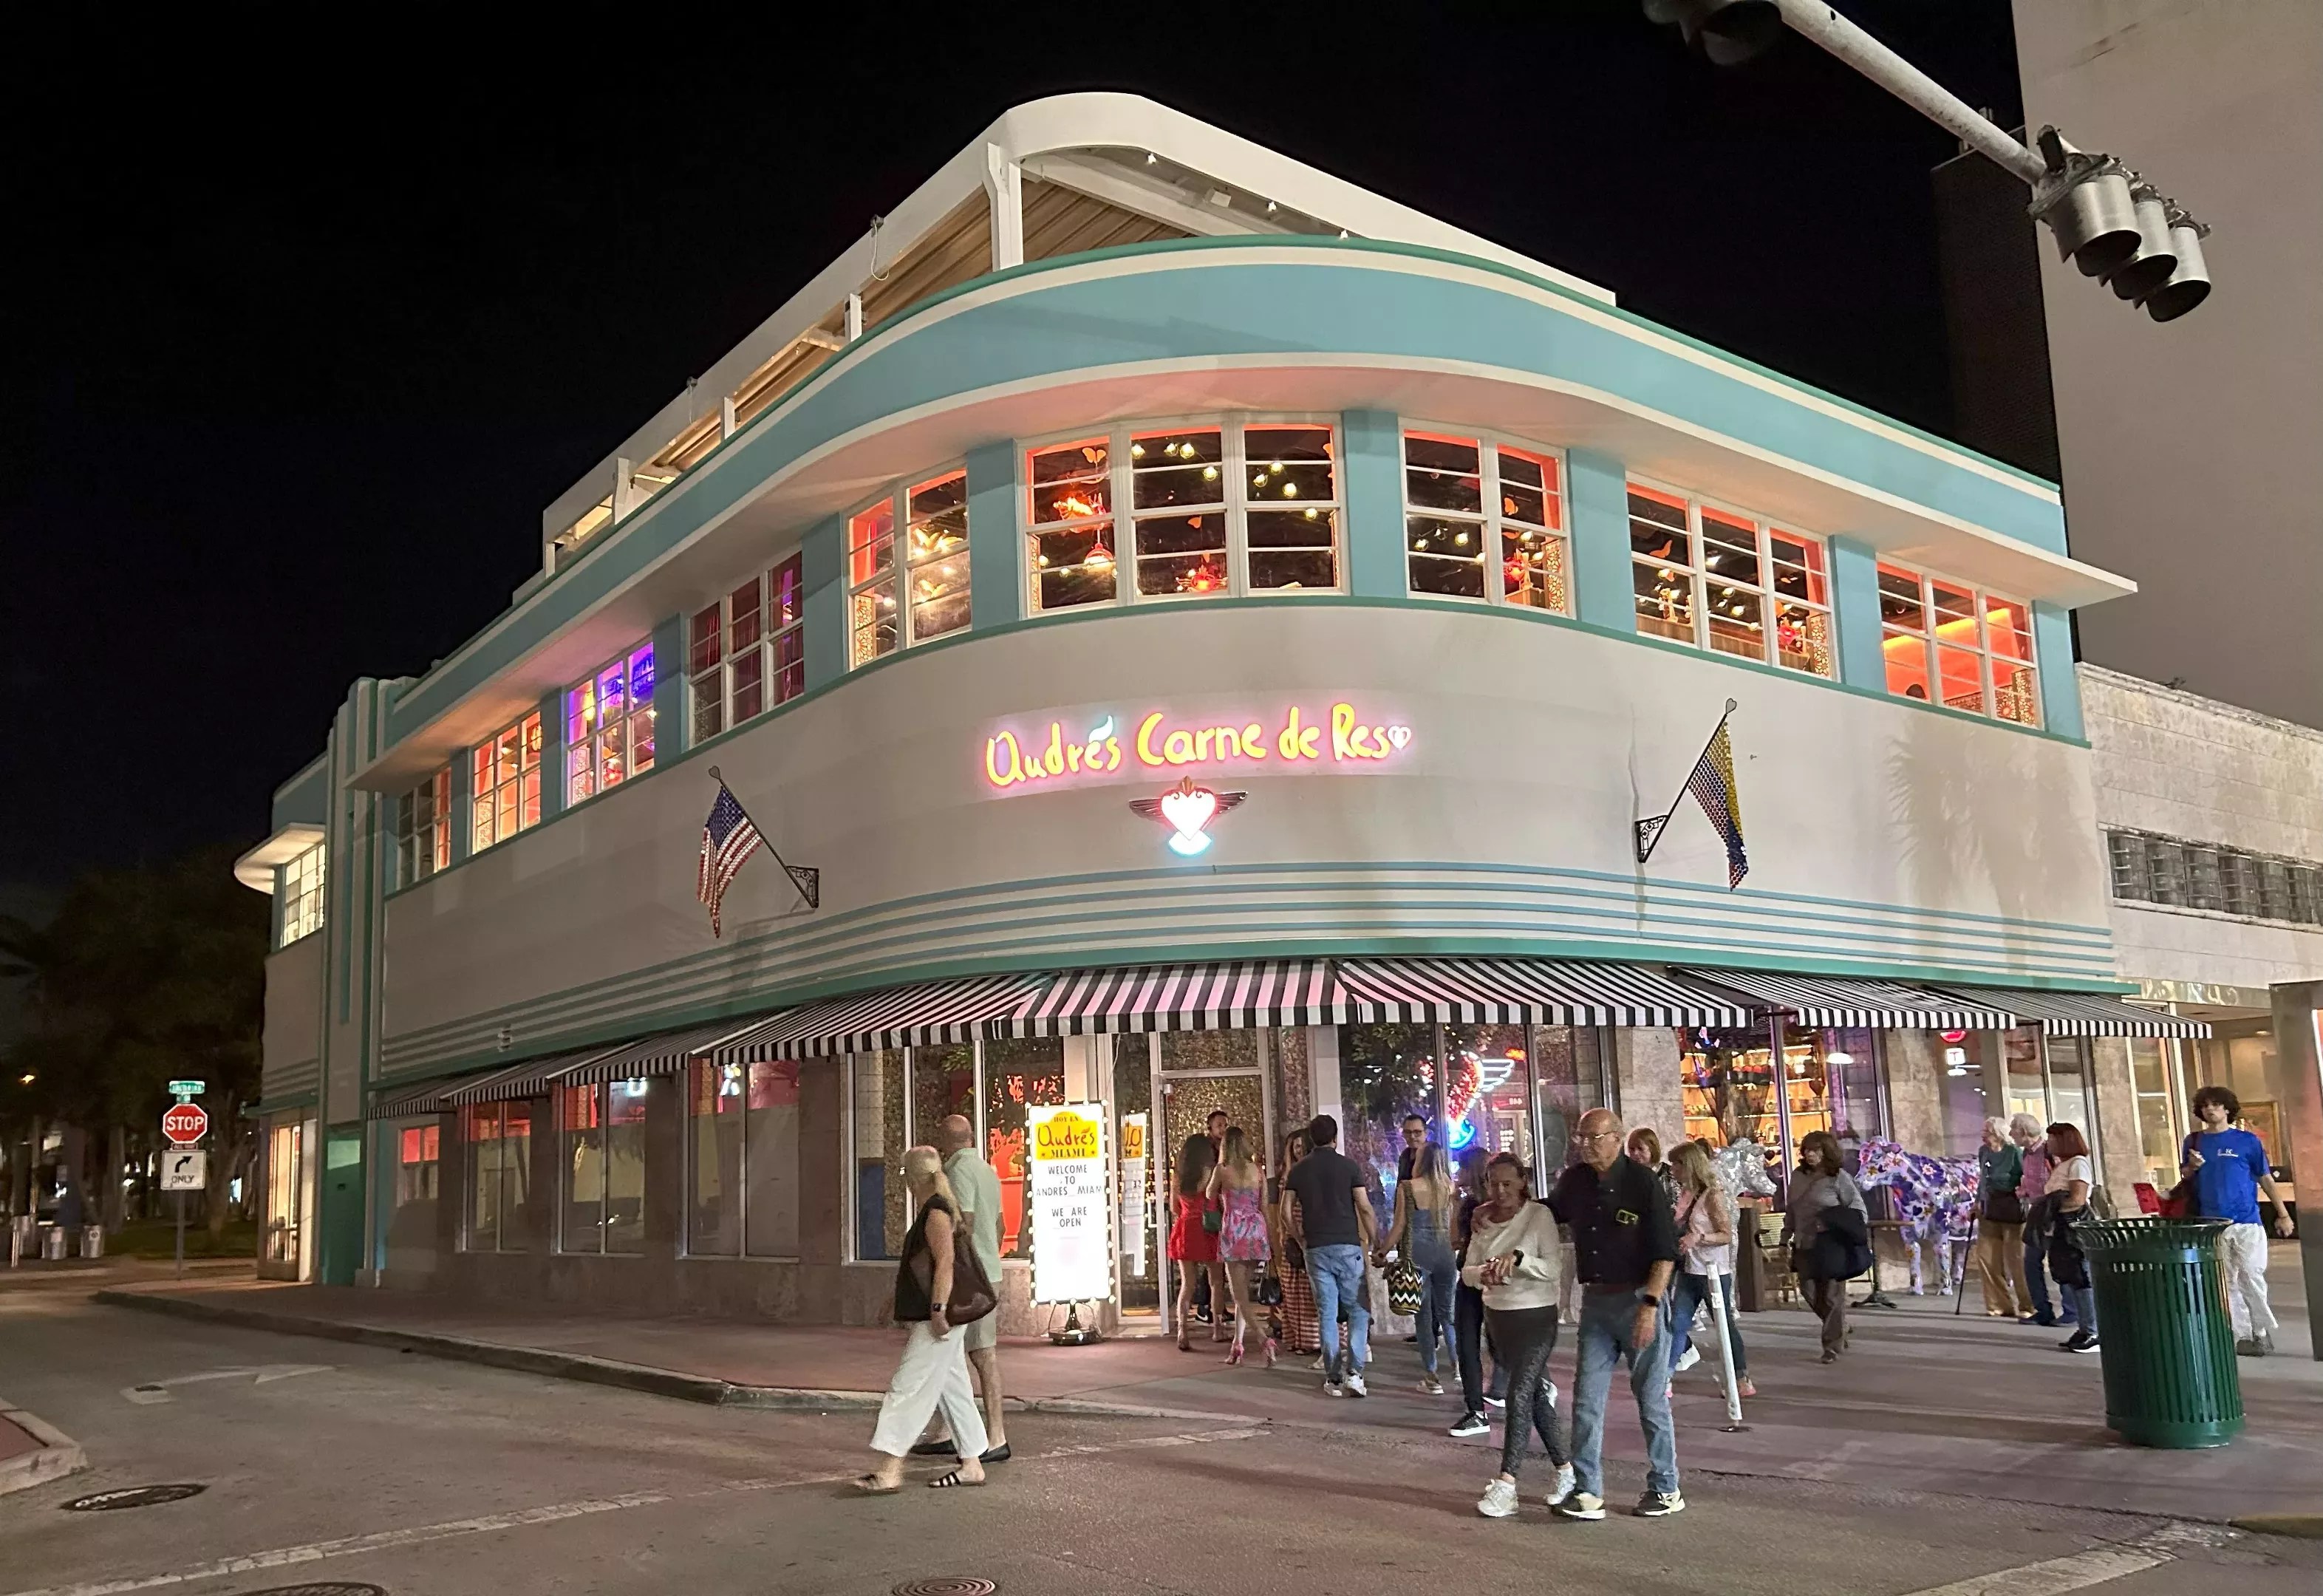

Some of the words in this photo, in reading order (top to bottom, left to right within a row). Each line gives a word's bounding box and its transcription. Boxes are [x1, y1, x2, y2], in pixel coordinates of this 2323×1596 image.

[1138, 712, 1266, 764] Carne
[1279, 706, 1320, 759] de
[1331, 703, 1391, 760] Res
[167, 1116, 204, 1131] STOP
[1051, 1148, 1085, 1159] MIAMI
[1048, 1164, 1088, 1175] WELCOME
[172, 1176, 194, 1184] ONLY
[1065, 1176, 1075, 1184] TO
[1037, 1186, 1068, 1196] ANDRES
[1052, 1208, 1063, 1217] WE
[1071, 1207, 1087, 1215] ARE
[1060, 1218, 1080, 1227] OPEN
